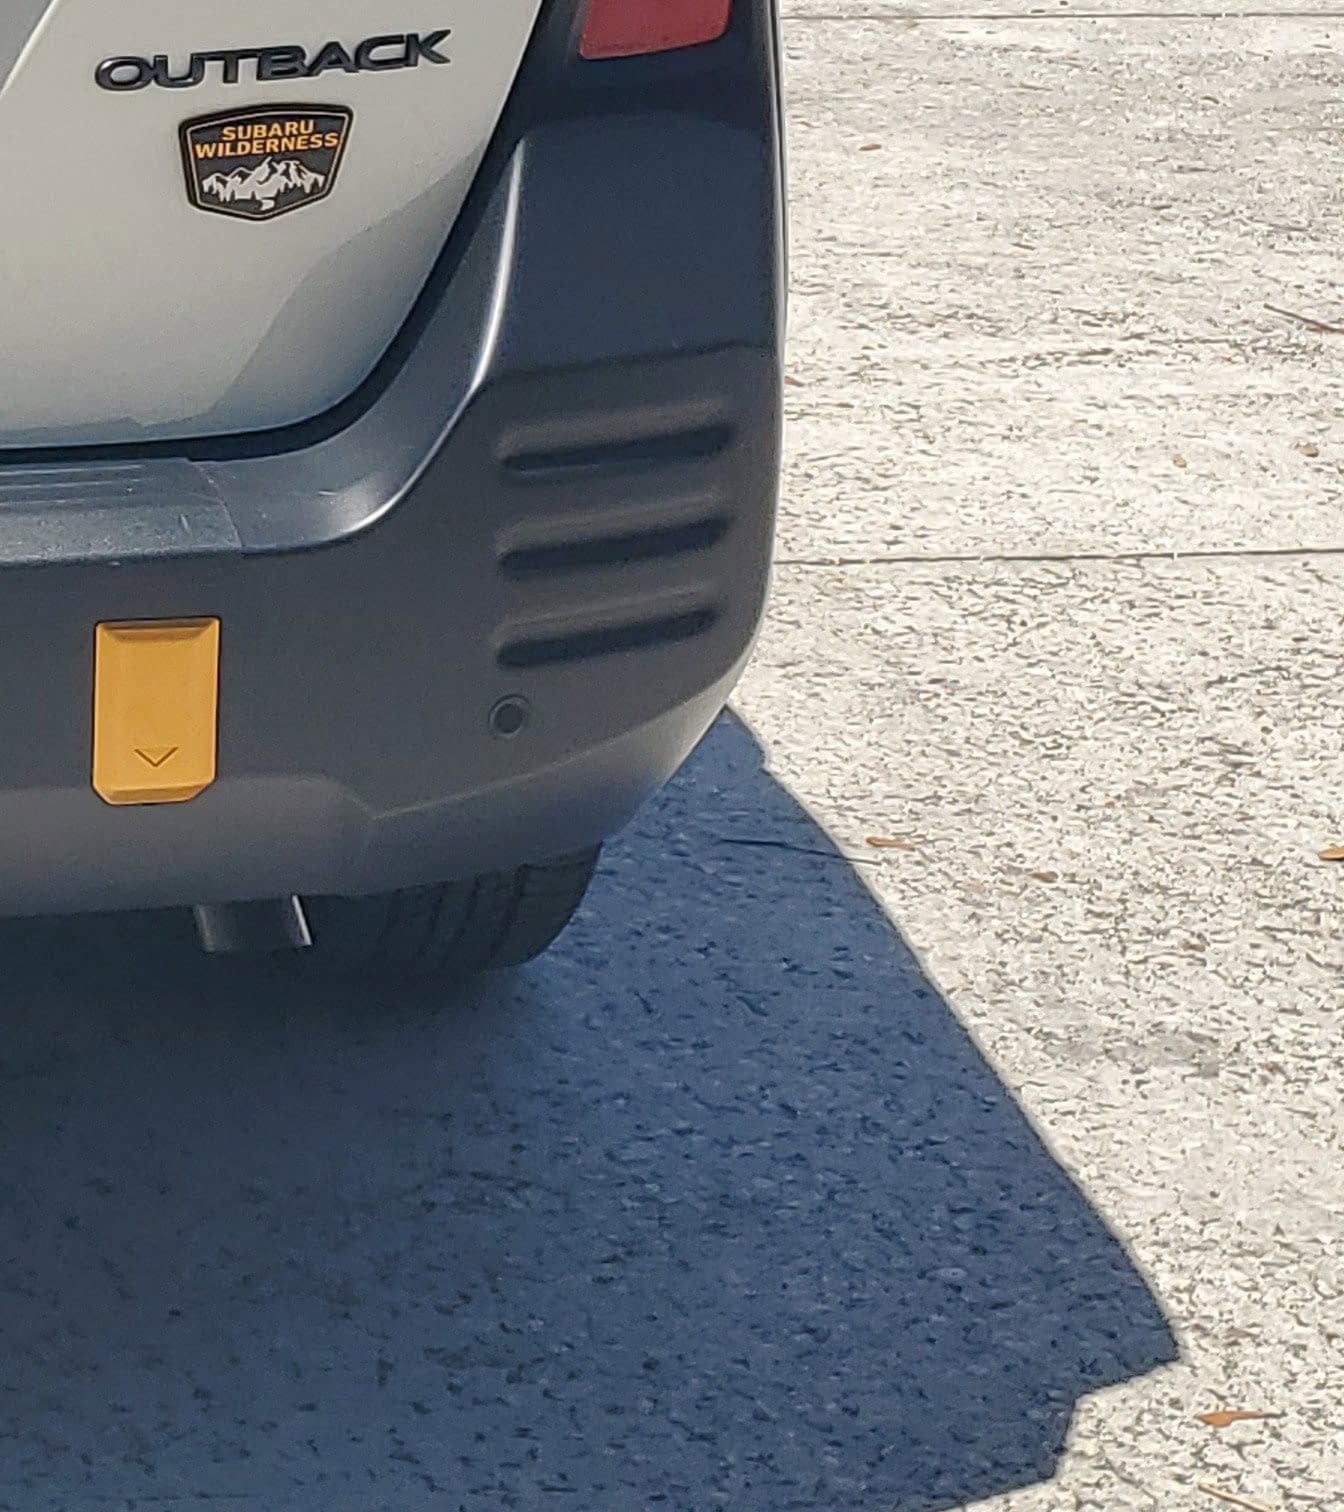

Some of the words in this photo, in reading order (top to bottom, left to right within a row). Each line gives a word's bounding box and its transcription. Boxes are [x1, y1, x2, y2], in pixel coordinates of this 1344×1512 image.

[94, 28, 452, 91] OUTBACK
[221, 119, 315, 142] SUBARU
[195, 131, 340, 159] WILDERNESS
